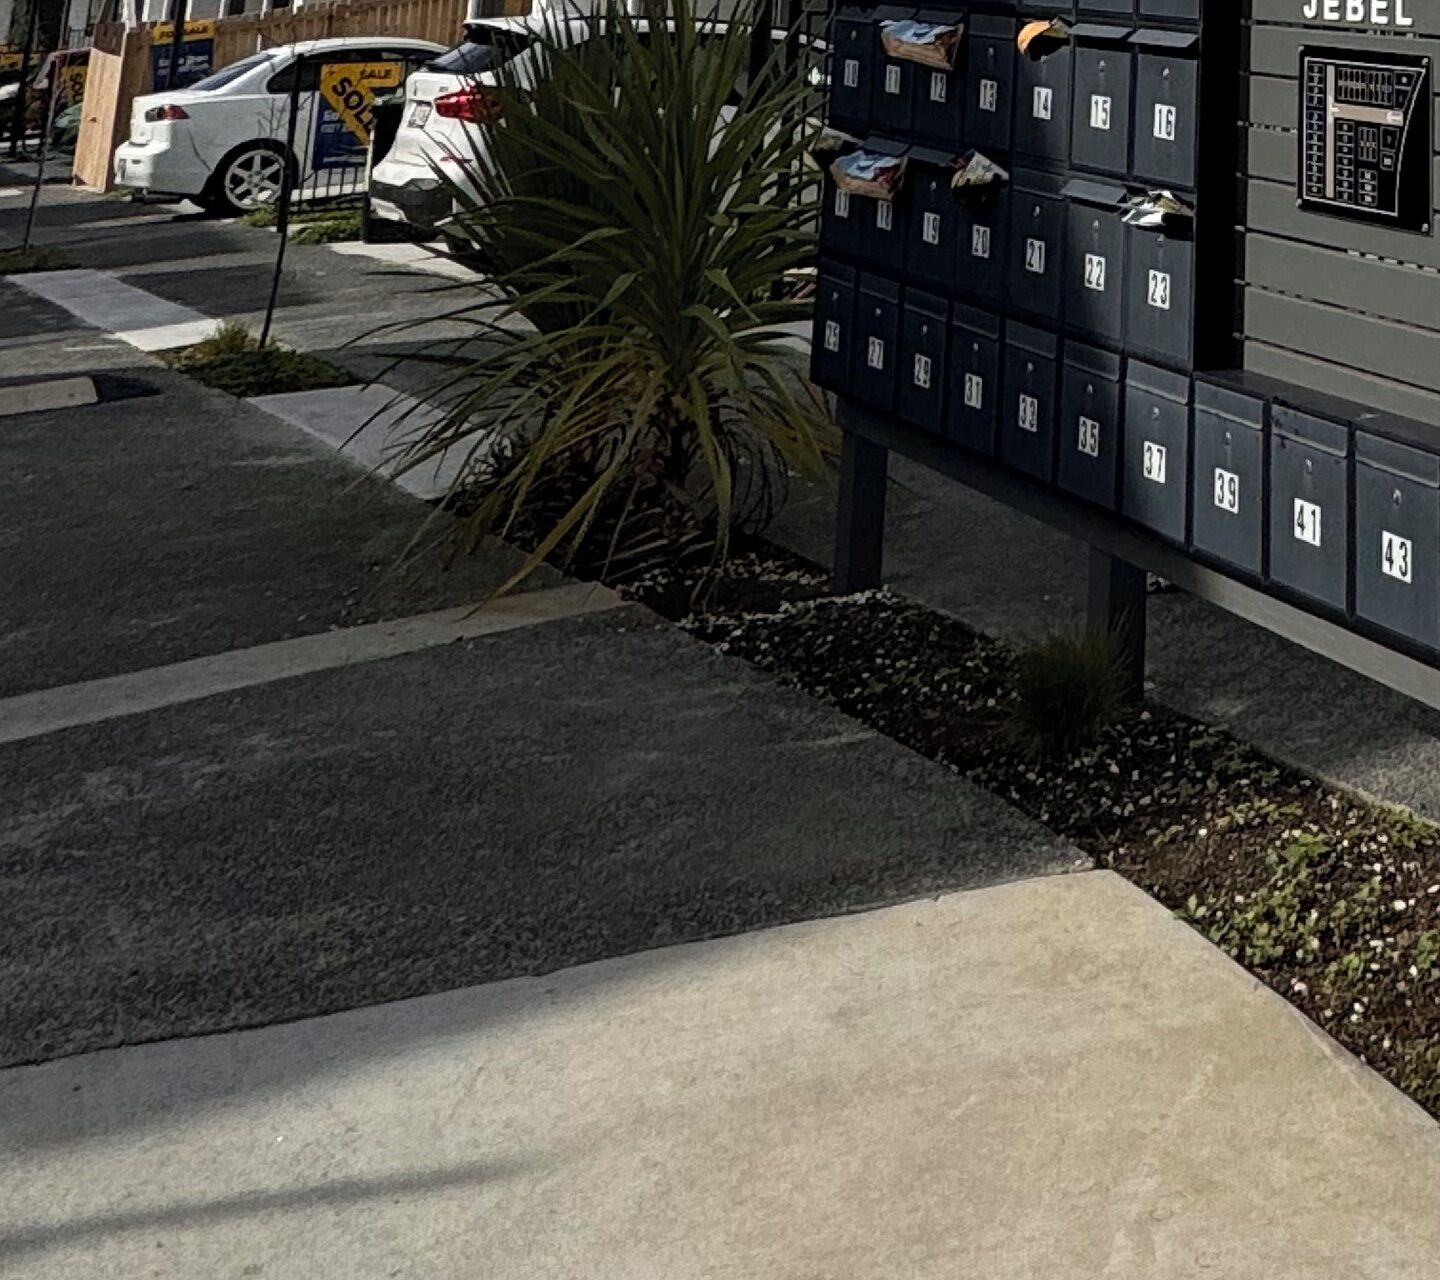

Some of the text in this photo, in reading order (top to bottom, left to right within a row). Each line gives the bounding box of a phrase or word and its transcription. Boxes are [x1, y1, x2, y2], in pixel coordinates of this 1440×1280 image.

[932, 76, 944, 99] 12
[982, 82, 995, 109] 13
[1035, 89, 1050, 115] 14
[1094, 99, 1109, 127] 15
[1158, 108, 1173, 137] 16
[925, 215, 937, 241] 19
[974, 228, 987, 254] 20
[1028, 241, 1043, 268] 21
[1087, 257, 1103, 287] 22
[1152, 273, 1167, 304] 23
[870, 340, 882, 366] 27
[916, 356, 928, 385] 29
[1022, 396, 1035, 428] 33
[1081, 420, 1097, 452] 35
[1146, 445, 1163, 477] 37
[1218, 473, 1235, 508] 39
[1297, 505, 1316, 542] 41
[1385, 538, 1407, 577] 43
